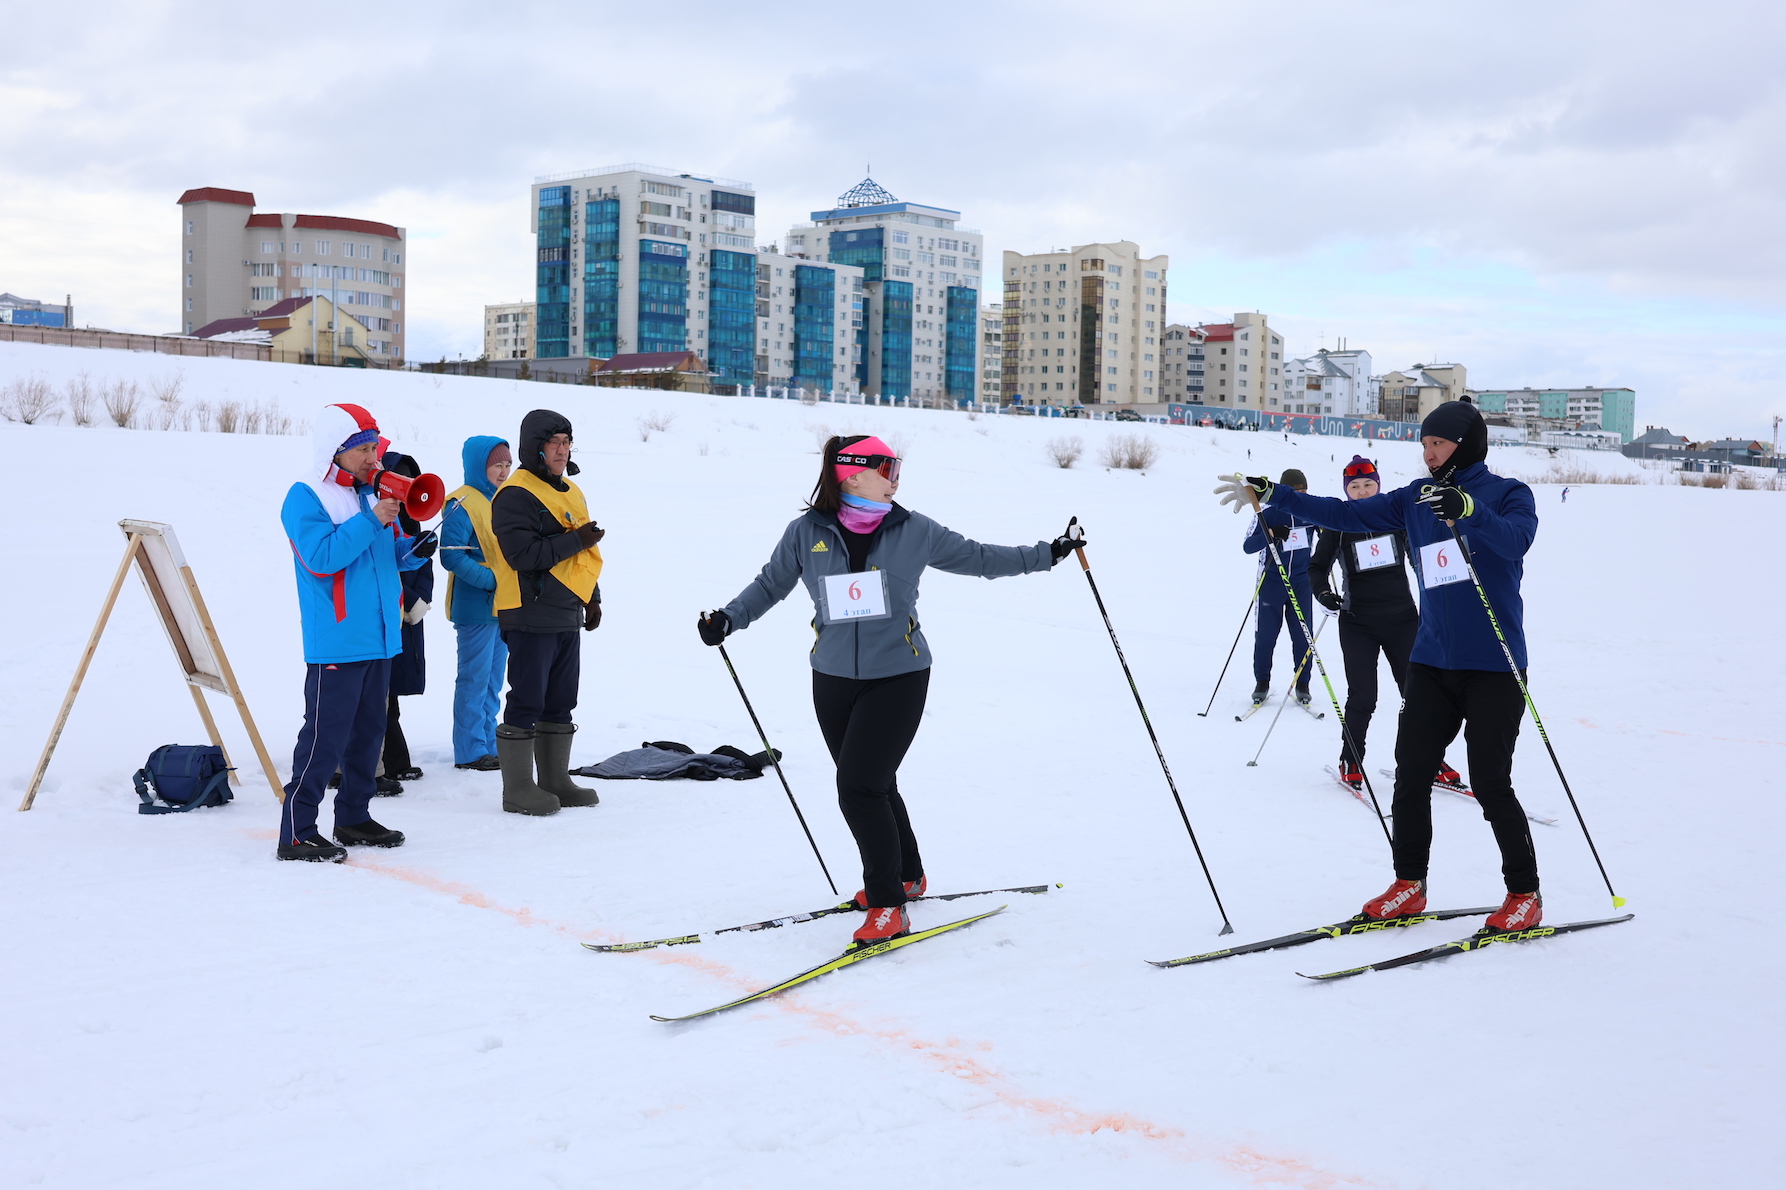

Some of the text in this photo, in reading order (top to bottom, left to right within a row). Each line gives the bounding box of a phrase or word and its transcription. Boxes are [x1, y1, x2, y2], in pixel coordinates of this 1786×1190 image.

[1292, 532, 1298, 542] 5
[1370, 543, 1380, 557] 8
[1437, 547, 1449, 568] 6
[1434, 574, 1458, 585] 3 этап
[848, 580, 862, 601] 6
[843, 608, 871, 617] 4 этап
[1381, 880, 1422, 916] alpina
[875, 906, 897, 931] alpi
[1477, 927, 1556, 949] FISCHER
[853, 941, 891, 961] FISCHER
